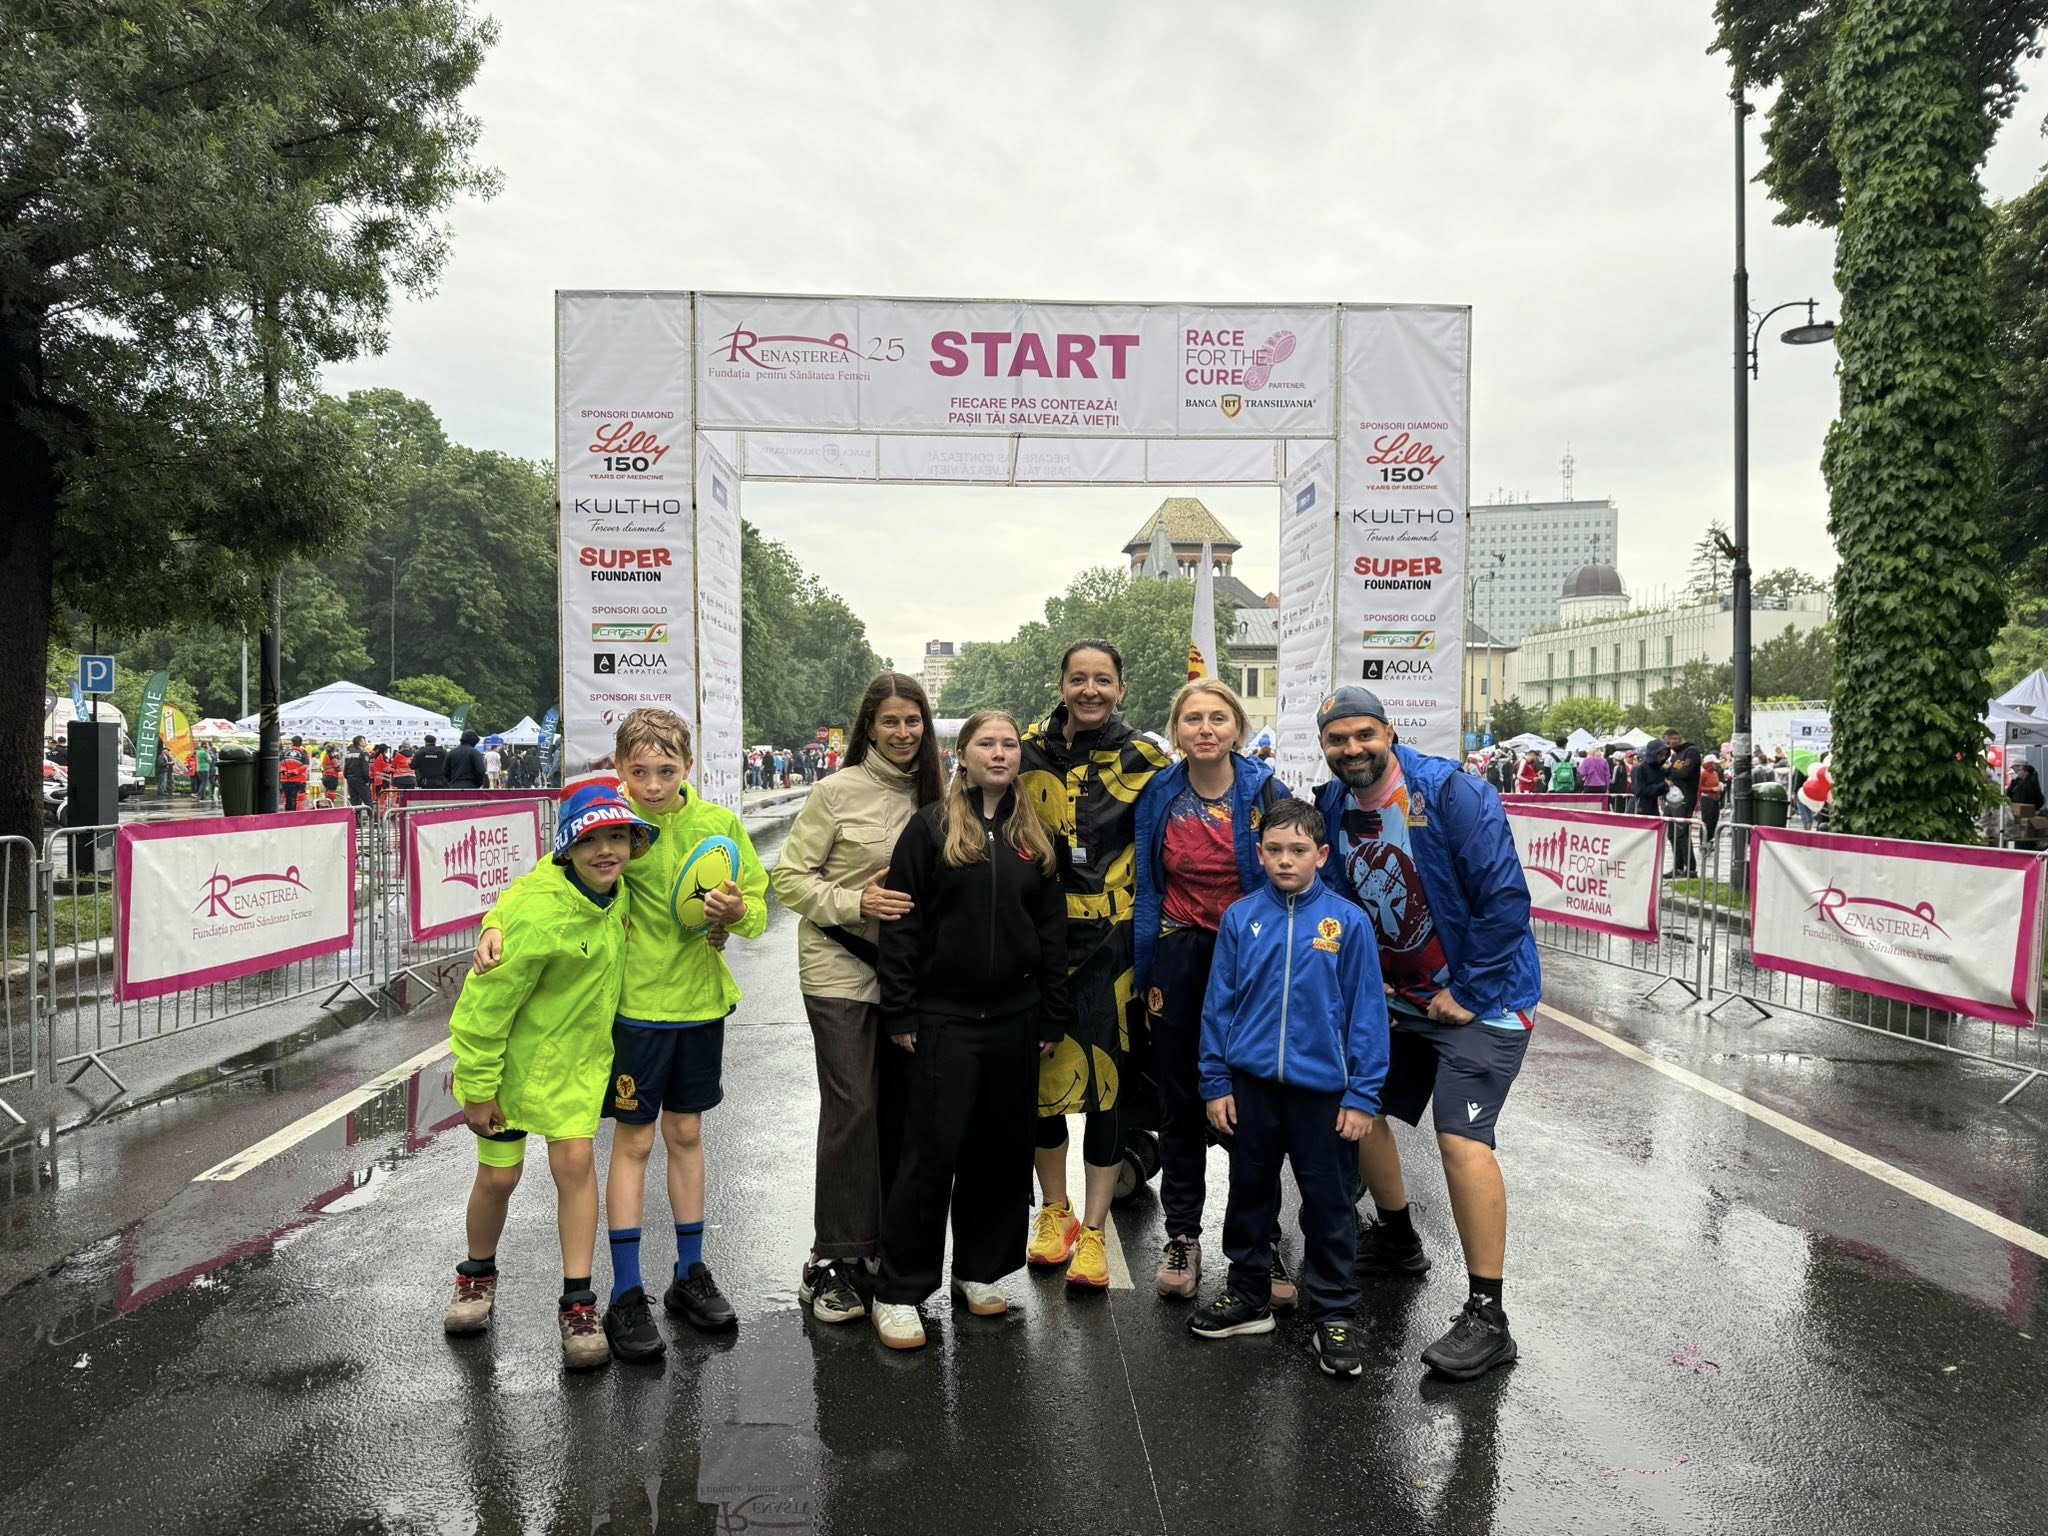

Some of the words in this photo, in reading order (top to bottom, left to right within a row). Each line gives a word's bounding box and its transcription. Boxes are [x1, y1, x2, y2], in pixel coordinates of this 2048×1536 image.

[716, 320, 849, 370] RENAȘTEREA
[1186, 329, 1244, 346] RACE
[865, 337, 905, 362] 25
[929, 330, 1140, 379] START
[1186, 349, 1226, 366] FOR
[1229, 349, 1267, 366] THE
[708, 366, 750, 380] Fundația
[756, 369, 788, 382] pentru
[789, 368, 836, 381] Sănătatea
[1185, 368, 1243, 386] CURE
[951, 397, 1007, 409] FIECARE
[1011, 399, 1037, 410] PAS
[1041, 397, 1118, 411] CONTEAZĂ!
[1185, 399, 1217, 408] BANCA
[1225, 399, 1237, 408] BT
[1244, 399, 1313, 409] TRANSILVANIA
[581, 410, 629, 419] SPONSORI
[631, 411, 674, 419] DIAMOND
[949, 412, 981, 426] PAȘII
[985, 410, 1005, 424] TĂI
[1008, 411, 1079, 426] SALVEAZĂ
[1083, 412, 1119, 430] VIEȚI!
[1360, 422, 1405, 430] SPONSORI
[1407, 422, 1449, 430] DIAMOND
[589, 421, 670, 465] Lilly
[1366, 432, 1445, 475] Lilly
[603, 457, 650, 472] 150
[1380, 467, 1424, 482] 150
[575, 498, 680, 514] KULTHO
[1353, 508, 1454, 524] KULTHO
[588, 519, 620, 532] Forever
[622, 521, 666, 532] diamonds
[1364, 528, 1395, 541] Forever
[1396, 530, 1439, 541] diamonds
[579, 547, 672, 569] SUPER
[1353, 556, 1442, 577] SUPER
[591, 570, 662, 582] FOUNDATION
[1364, 579, 1431, 590] FOUNDATION
[592, 606, 640, 614] SPONSORI
[641, 606, 668, 614] GOLD
[1363, 614, 1409, 622] SPONSORI
[1410, 614, 1436, 622] GOLD
[617, 653, 668, 668] AQUA
[1385, 660, 1433, 674] AQUA
[87, 660, 107, 688] P
[589, 693, 637, 702] SPONSORI
[640, 693, 672, 701] SILVER
[1383, 698, 1404, 707] SORI
[1406, 699, 1437, 708] SILVER
[138, 690, 163, 769] THERME
[1398, 736, 1418, 745] GLAS
[1483, 734, 1490, 744] P
[479, 827, 508, 848] RACE
[1570, 834, 1611, 855] RACE
[480, 849, 500, 868] FOR
[502, 845, 521, 863] THE
[1568, 854, 1595, 875] FOR
[1597, 858, 1626, 879] THE
[480, 867, 509, 889] CURE
[1566, 875, 1608, 898] CURE
[200, 864, 299, 918] RENAȘTEREA
[1566, 896, 1612, 916] ROMÂNIA
[193, 923, 229, 940] Fundația
[229, 919, 256, 936] pentru
